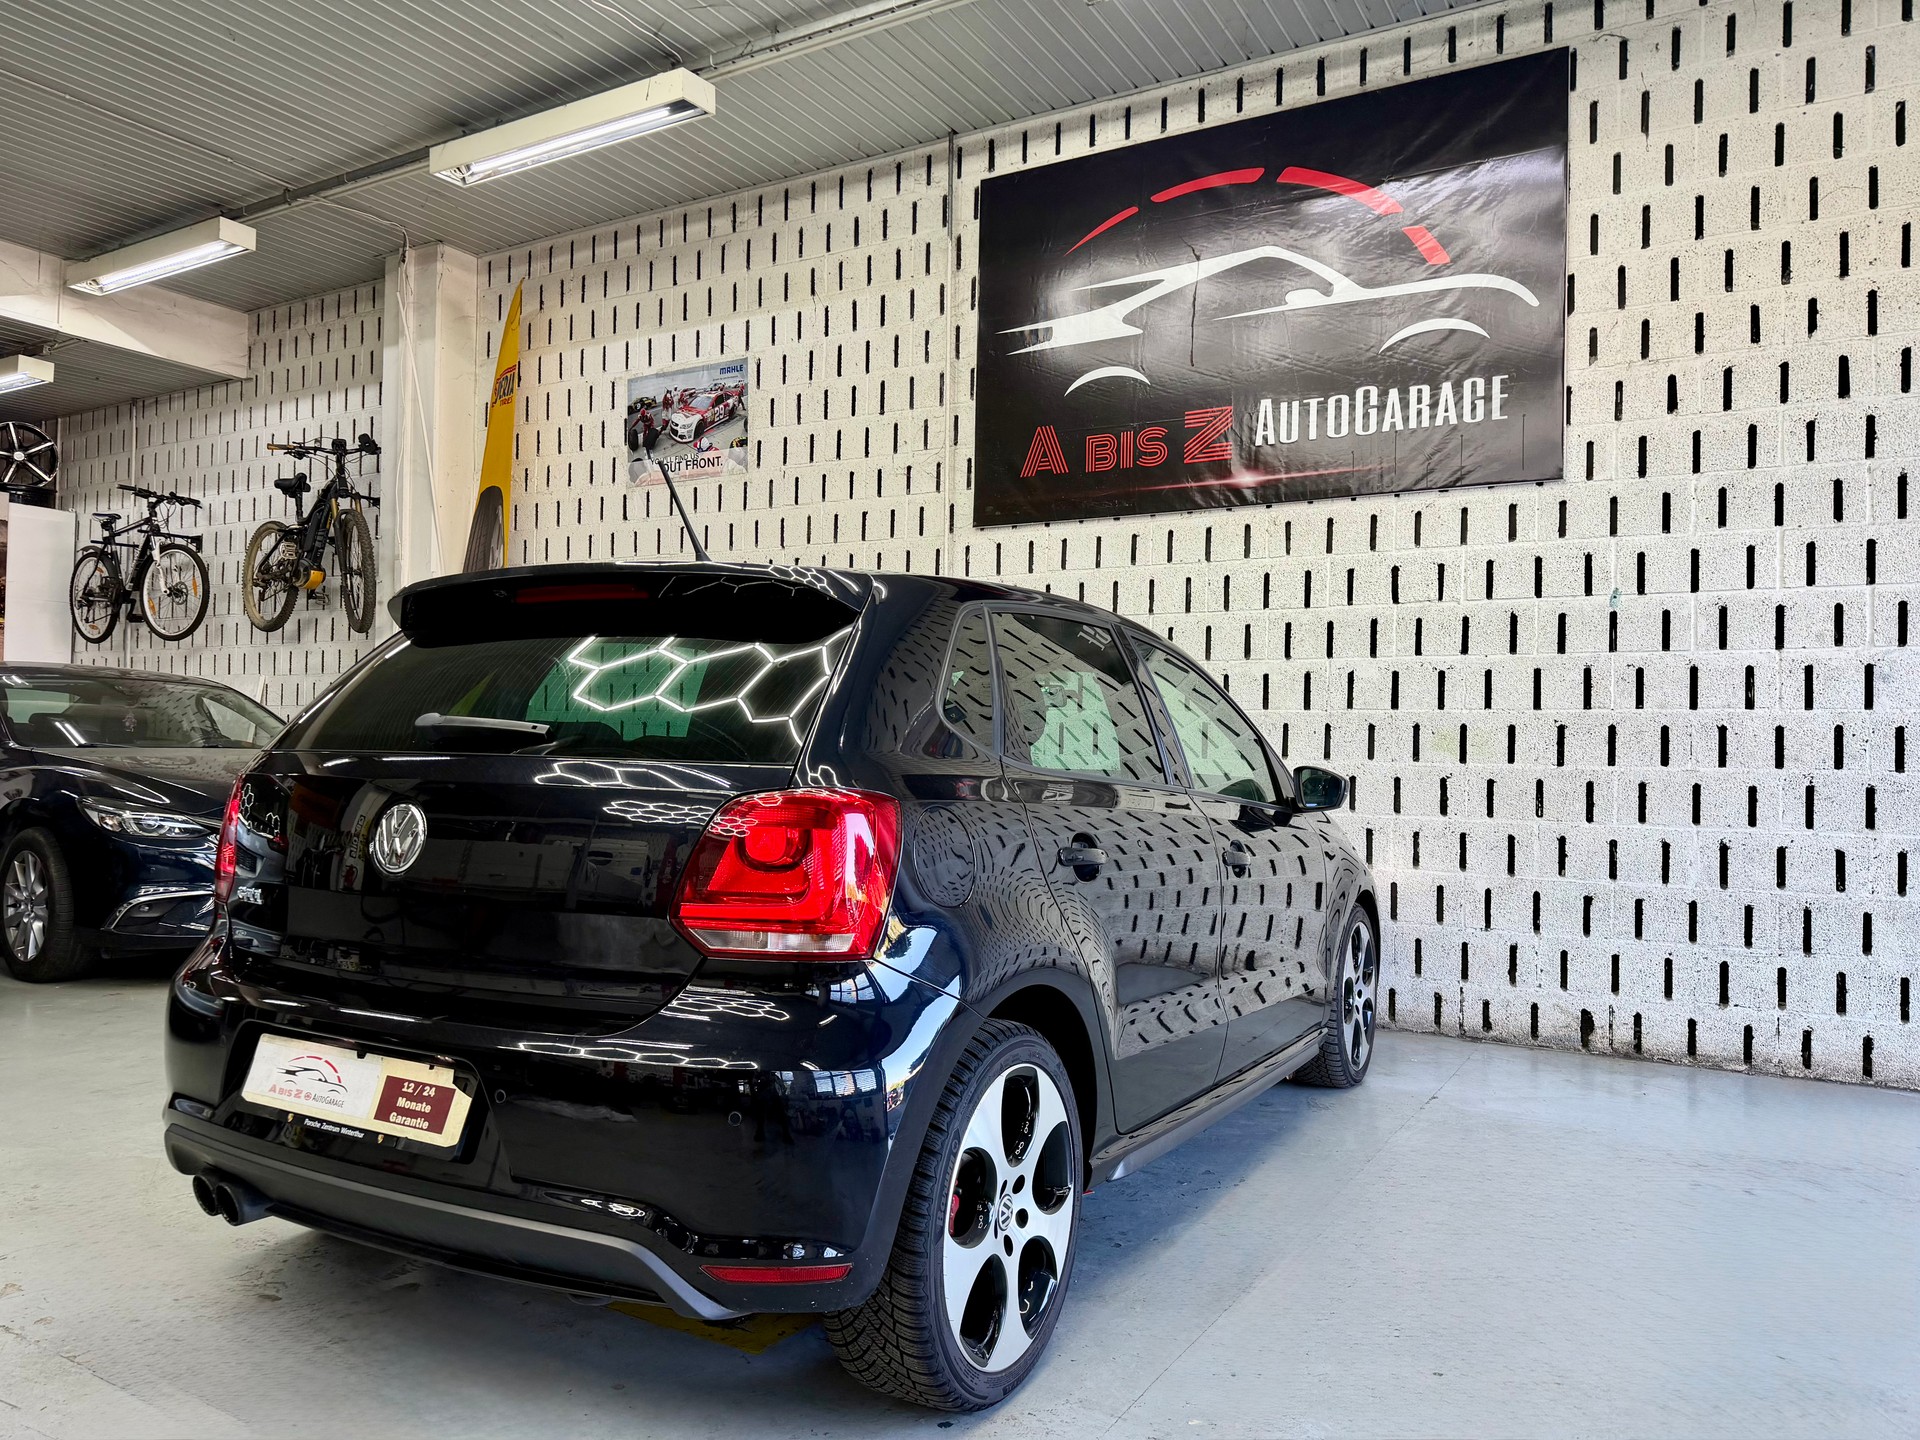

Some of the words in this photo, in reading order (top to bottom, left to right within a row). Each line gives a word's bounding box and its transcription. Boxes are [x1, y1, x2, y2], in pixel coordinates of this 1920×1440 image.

[719, 364, 744, 375] MAHLE
[714, 405, 725, 422] 29
[1020, 425, 1069, 478] A
[1085, 426, 1169, 473] BIS
[1183, 406, 1233, 464] Z
[1255, 375, 1509, 446] AUTOGARAGE
[675, 453, 689, 461] FIND
[690, 452, 700, 460] US
[686, 456, 723, 470] FRONT.
[268, 1084, 277, 1093] A
[278, 1087, 293, 1098] BIS
[293, 1088, 304, 1099] Z
[312, 1093, 345, 1108] AUTOGARAGE
[401, 1081, 415, 1093] 12
[422, 1086, 436, 1097] 24
[396, 1096, 432, 1113] Monate
[304, 1118, 321, 1128] Porsche
[321, 1122, 340, 1133] Zentrum
[340, 1126, 365, 1138] Winterthur
[389, 1111, 429, 1129] Garantie
